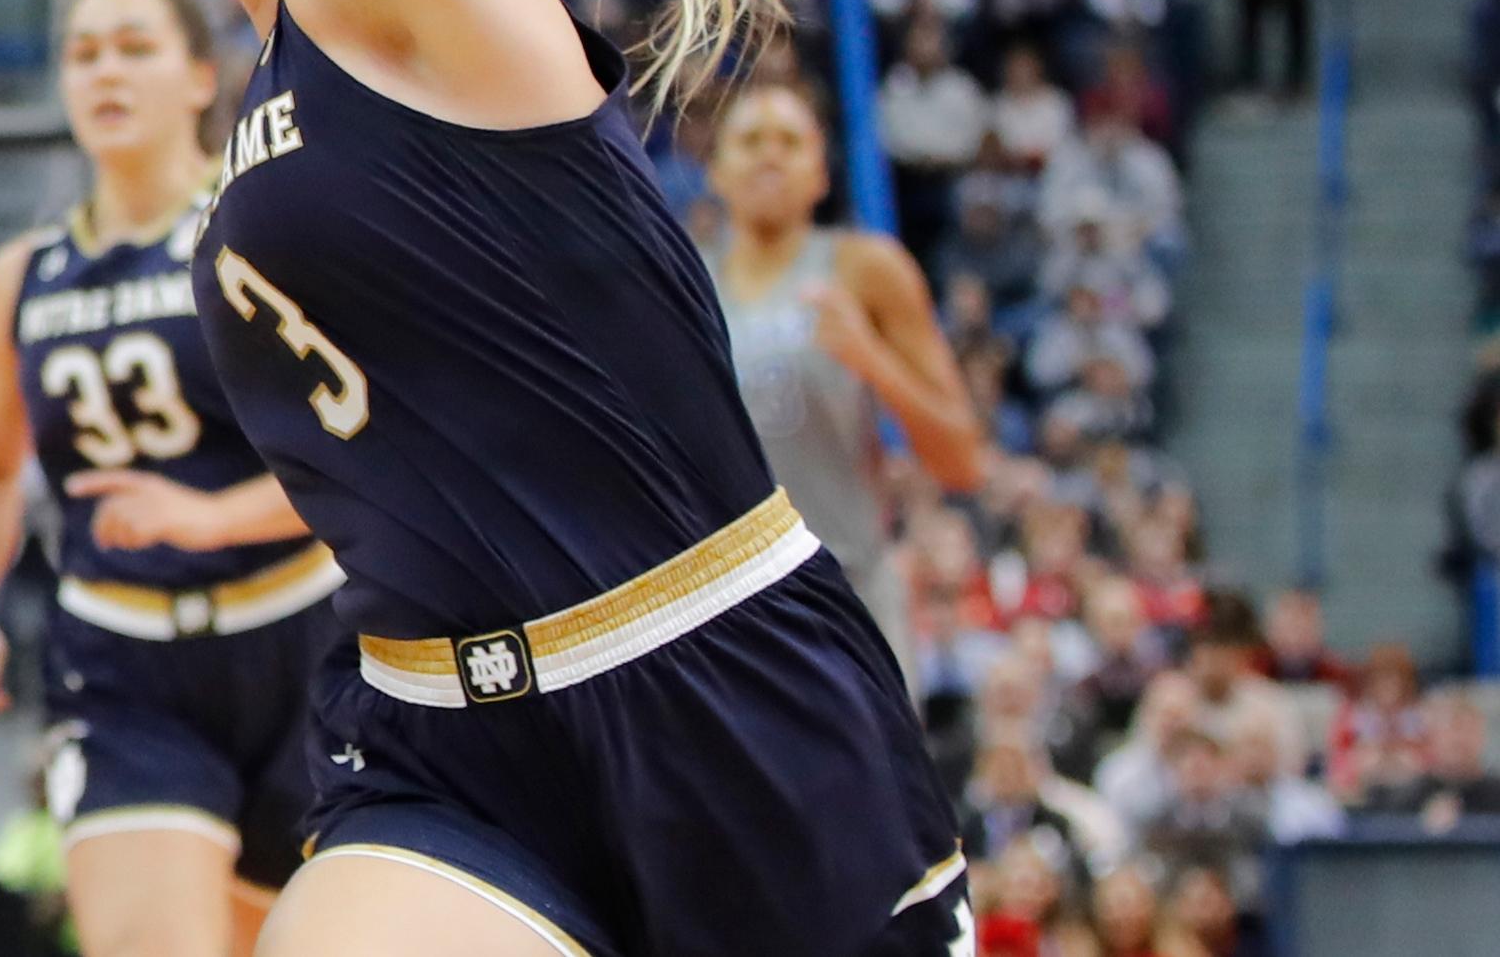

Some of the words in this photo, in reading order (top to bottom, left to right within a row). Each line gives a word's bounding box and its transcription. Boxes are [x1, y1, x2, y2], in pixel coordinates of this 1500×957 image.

[213, 89, 304, 207] AME
[40, 331, 202, 468] 33
[215, 245, 370, 441] 3
